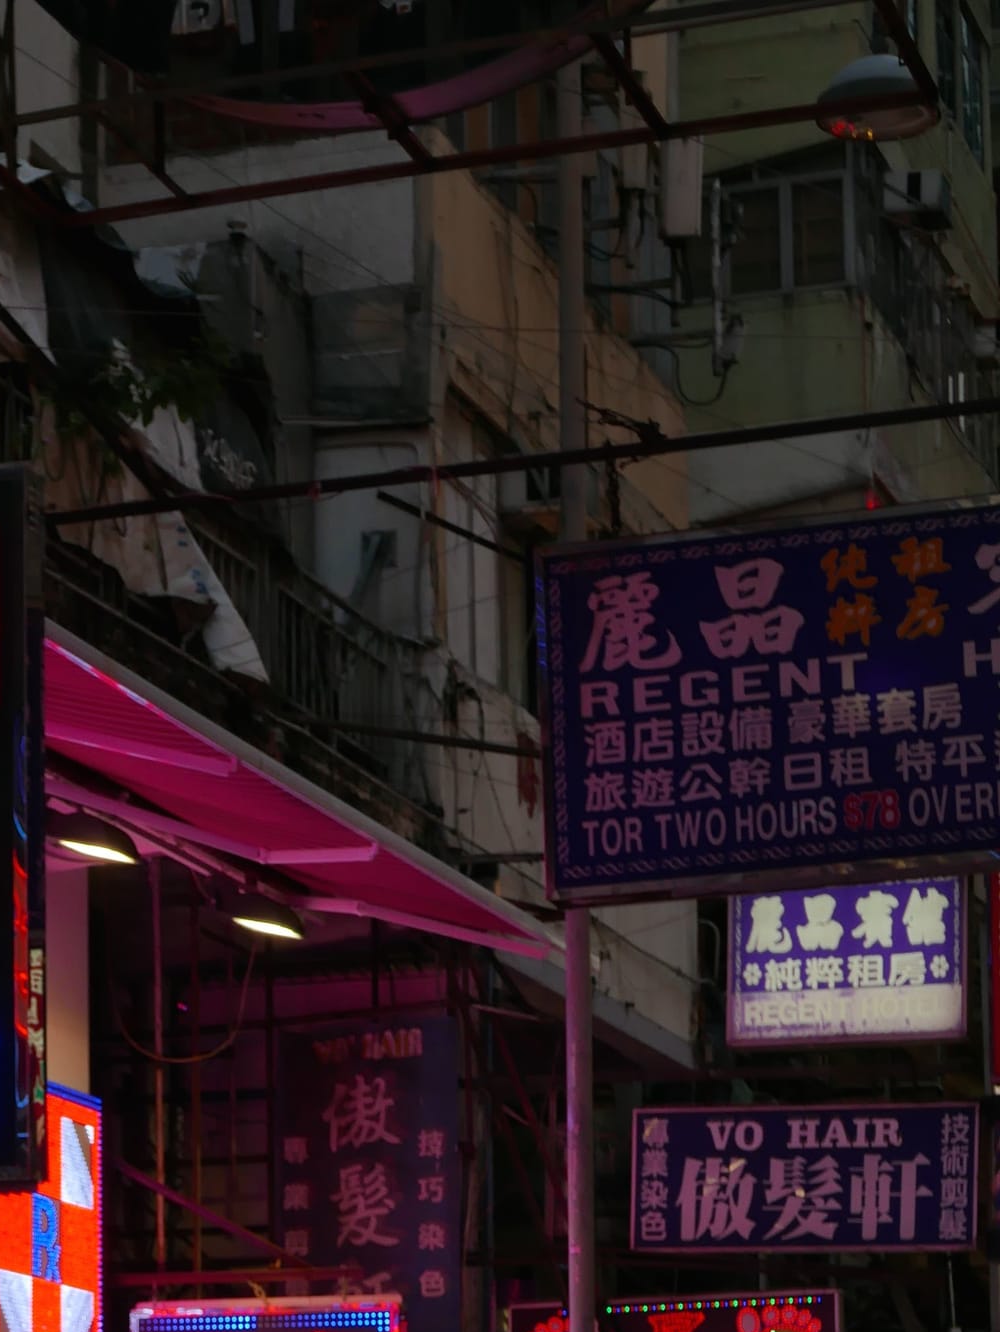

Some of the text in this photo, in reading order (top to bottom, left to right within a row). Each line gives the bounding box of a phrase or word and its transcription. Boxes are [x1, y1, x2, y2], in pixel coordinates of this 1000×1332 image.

[579, 652, 868, 718] REGENT
[585, 682, 963, 768] 酒店設備 豪華套房
[584, 757, 773, 812] 旅遊公幹
[783, 747, 873, 793] 日租
[582, 816, 644, 857] TOR
[654, 807, 728, 851] TWO
[735, 796, 838, 844] HOURS
[908, 783, 1000, 827] OVER
[705, 1116, 903, 1152] VO HAIR
[675, 1152, 934, 1242] 傲髮軒
